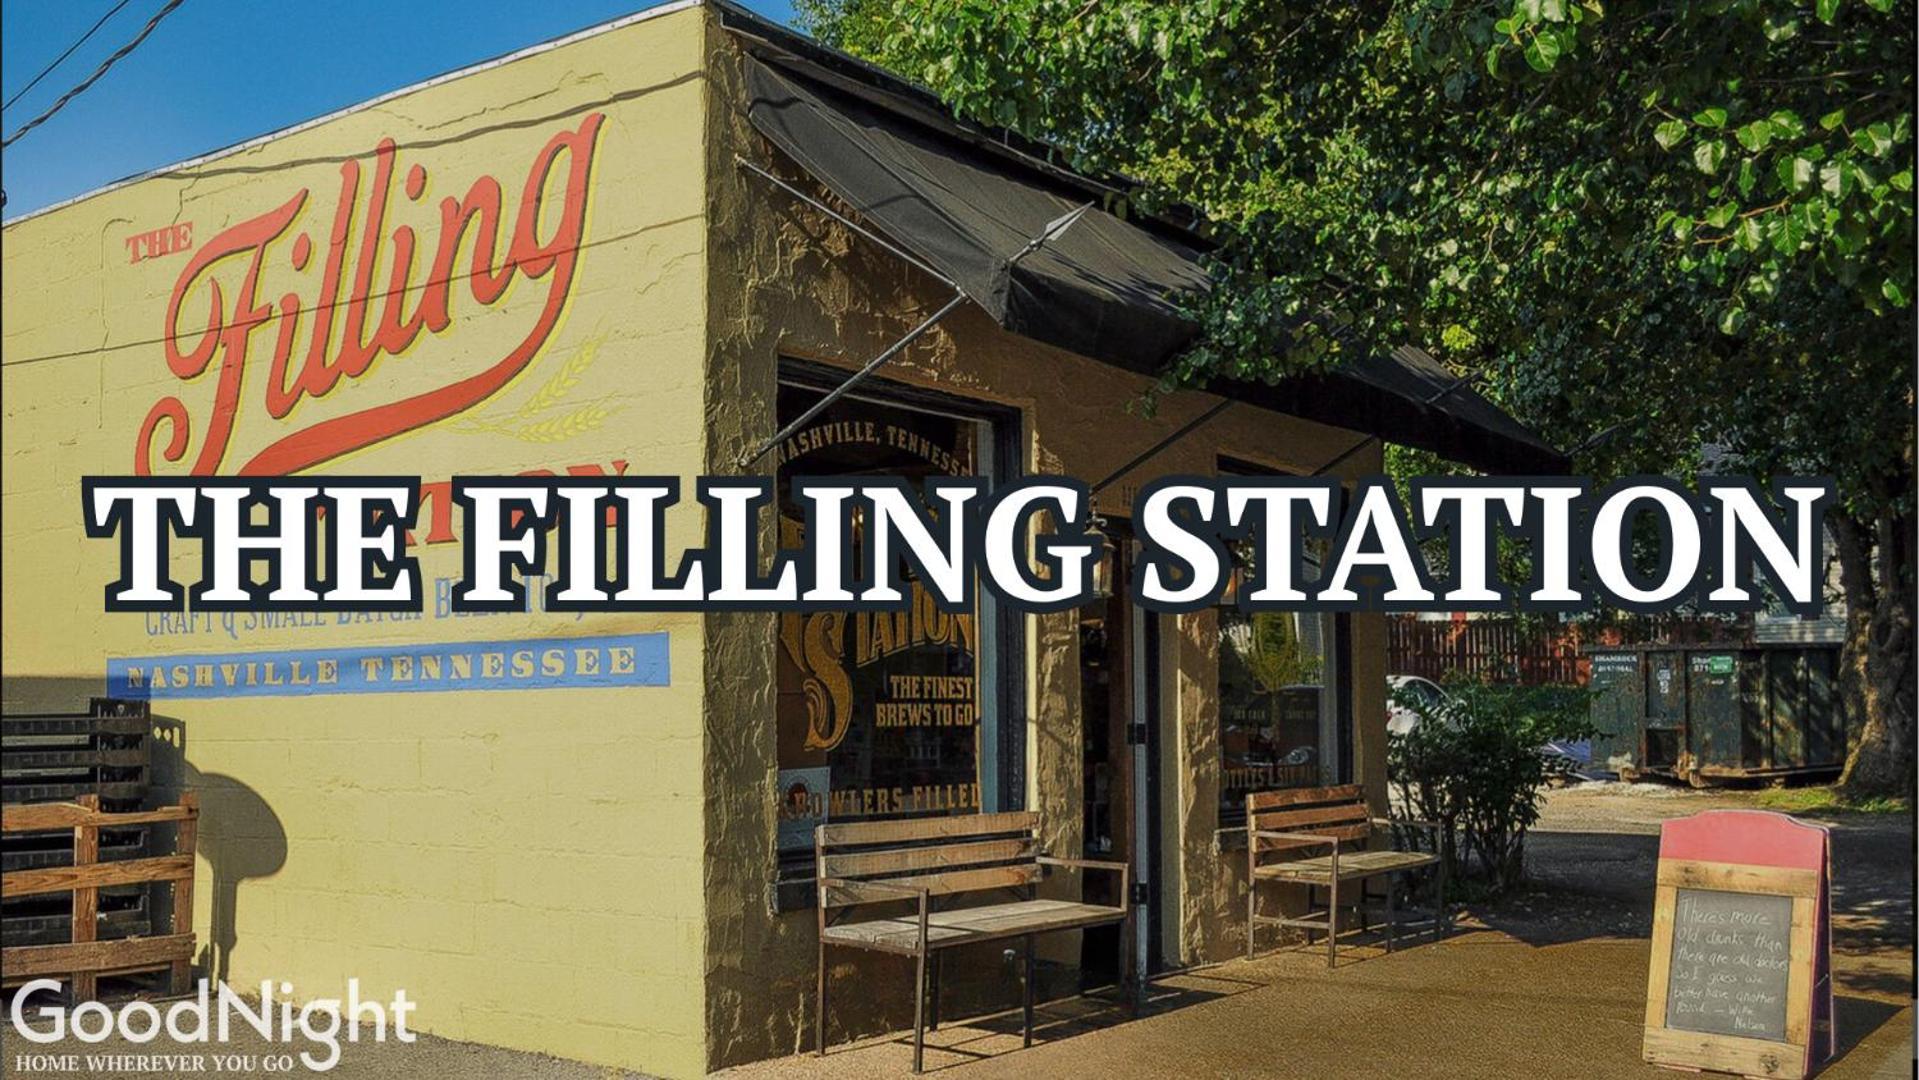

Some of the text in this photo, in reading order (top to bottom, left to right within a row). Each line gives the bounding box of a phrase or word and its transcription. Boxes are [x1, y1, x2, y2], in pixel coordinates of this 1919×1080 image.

[125, 222, 193, 265] THE
[134, 112, 606, 477] Filling
[777, 421, 881, 466] NASHVILLE,
[127, 646, 637, 690] NASHVILLE TENNESSEE
[890, 675, 974, 700] THE FINEST
[876, 703, 974, 728] BREWS TO GO
[912, 782, 980, 810] FILLED
[1730, 911, 1772, 928] more
[1709, 953, 1728, 967] are
